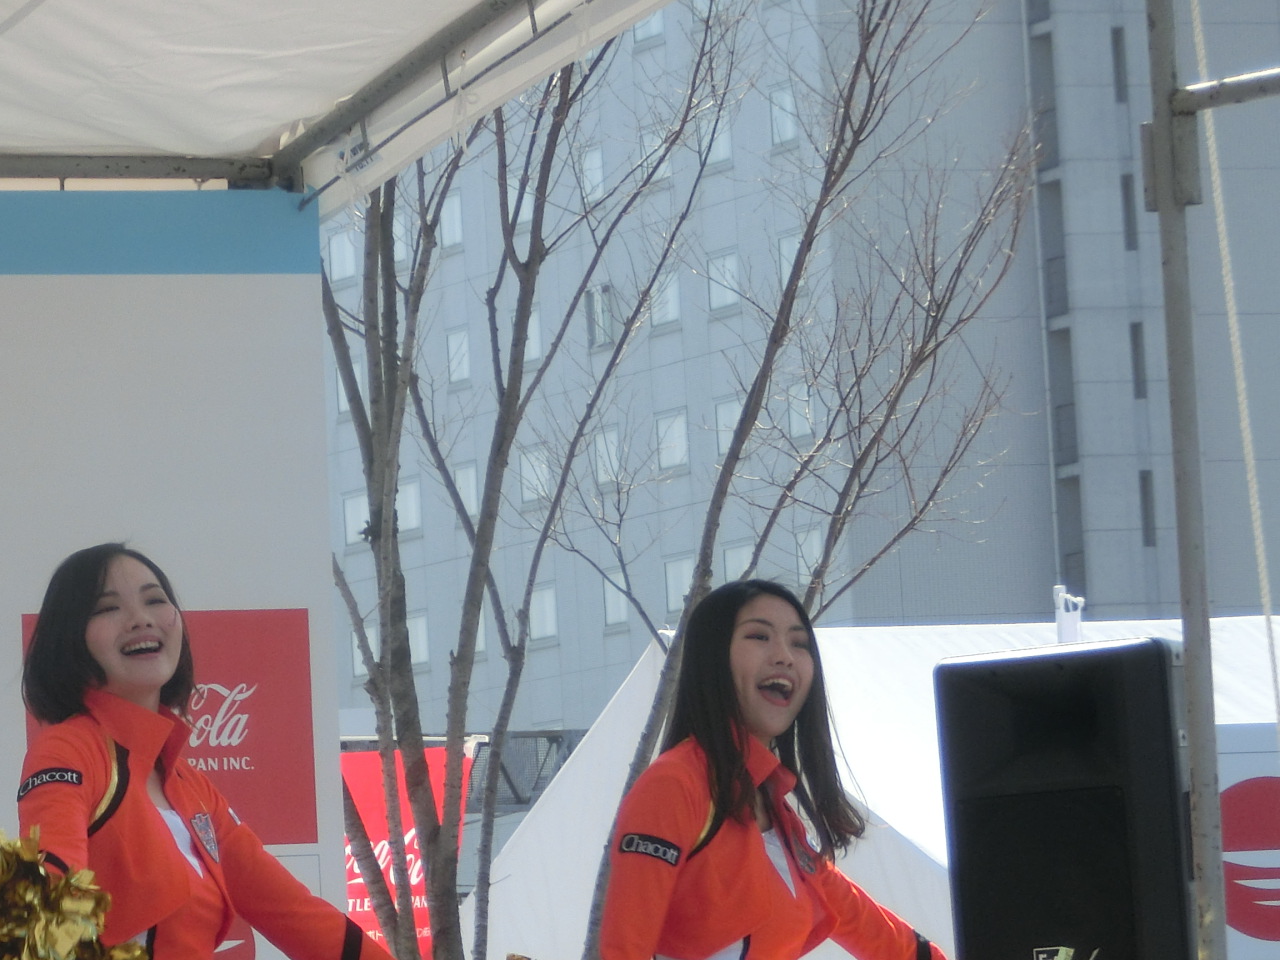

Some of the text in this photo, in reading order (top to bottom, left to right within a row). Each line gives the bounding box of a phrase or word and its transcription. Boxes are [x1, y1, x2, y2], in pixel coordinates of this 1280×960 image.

[188, 682, 258, 748] ola
[222, 756, 255, 771] INC.
[19, 770, 80, 797] Chacott
[621, 833, 679, 866] Chacott
